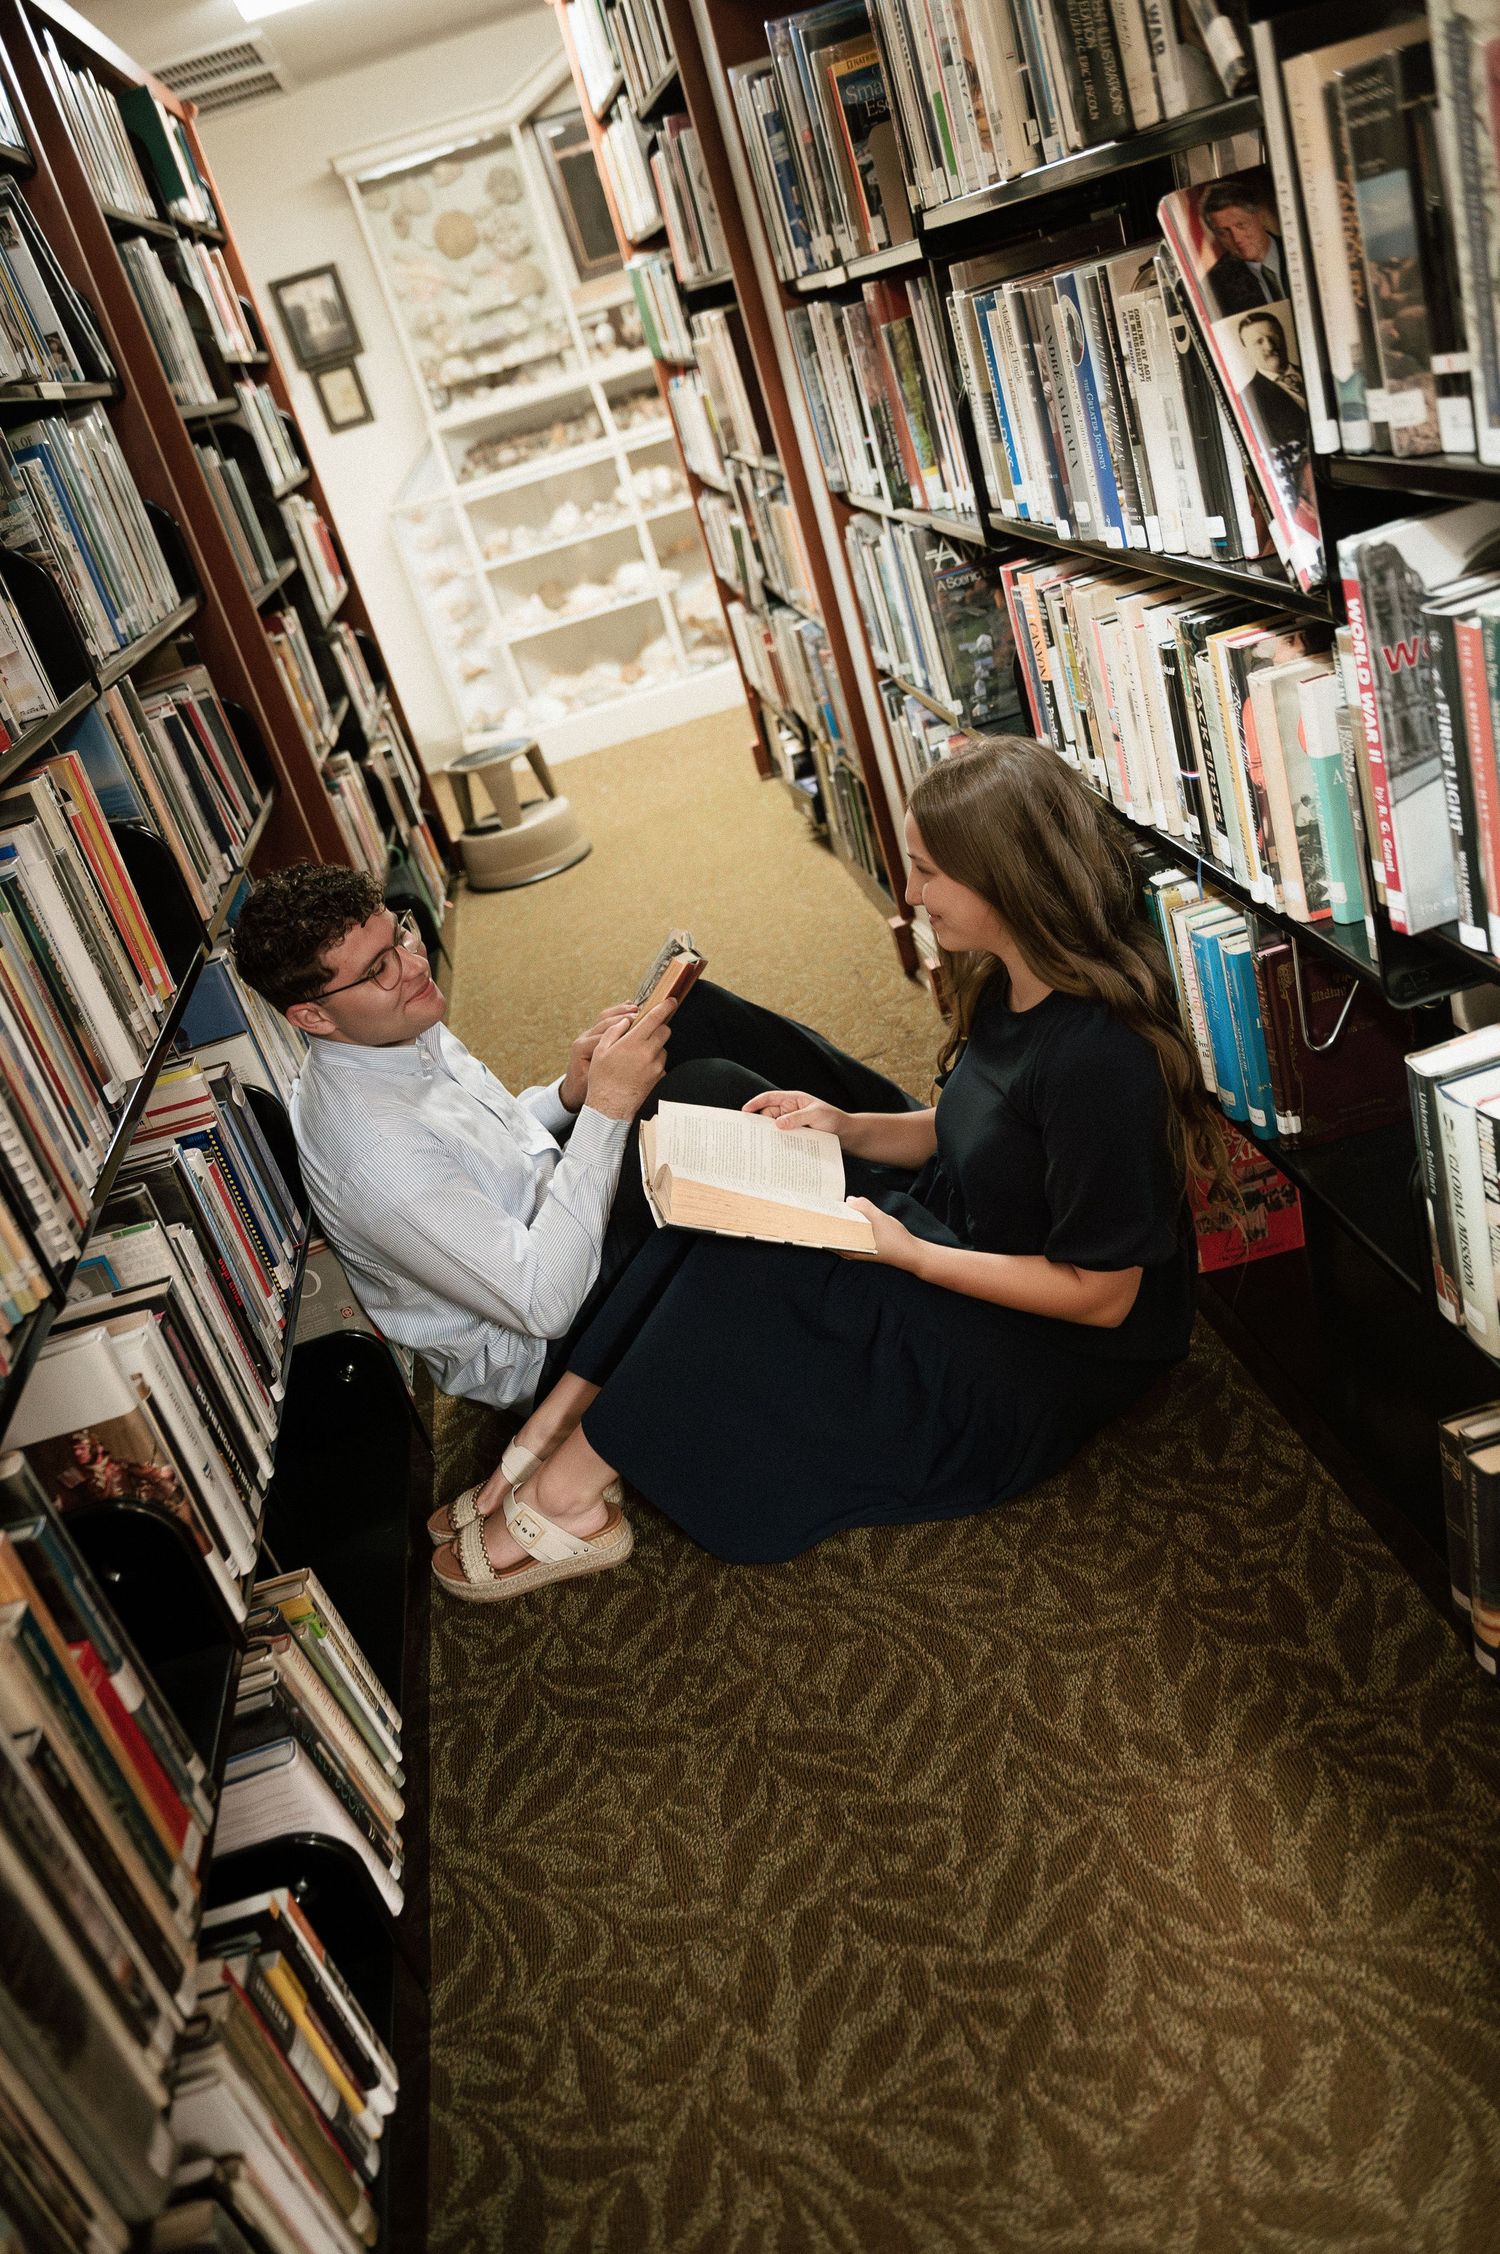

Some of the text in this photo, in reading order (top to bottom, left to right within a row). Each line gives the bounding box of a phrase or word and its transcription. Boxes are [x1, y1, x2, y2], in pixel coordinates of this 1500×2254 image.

[1127, 309, 1145, 383] IN MISSISSIPPI
[1134, 308, 1152, 382] COMING OF AGE
[1044, 323, 1078, 468] ANDRÉ MALRAUX
[1086, 392, 1098, 431] GREATER
[1094, 432, 1105, 470] JOURNEY
[1031, 621, 1047, 677] CANYON
[1347, 597, 1381, 764] WORLD WAR II
[1041, 682, 1062, 746] Lin Pardey
[1190, 663, 1223, 823] BLACK FIRSTS
[1436, 701, 1454, 767] FIRST
[1445, 767, 1462, 836] LIGHT
[1374, 785, 1395, 873] by R. G. Grant
[1419, 1091, 1437, 1195] Unknown Soldiers
[1451, 1154, 1474, 1292] GLOBAL MISSION
